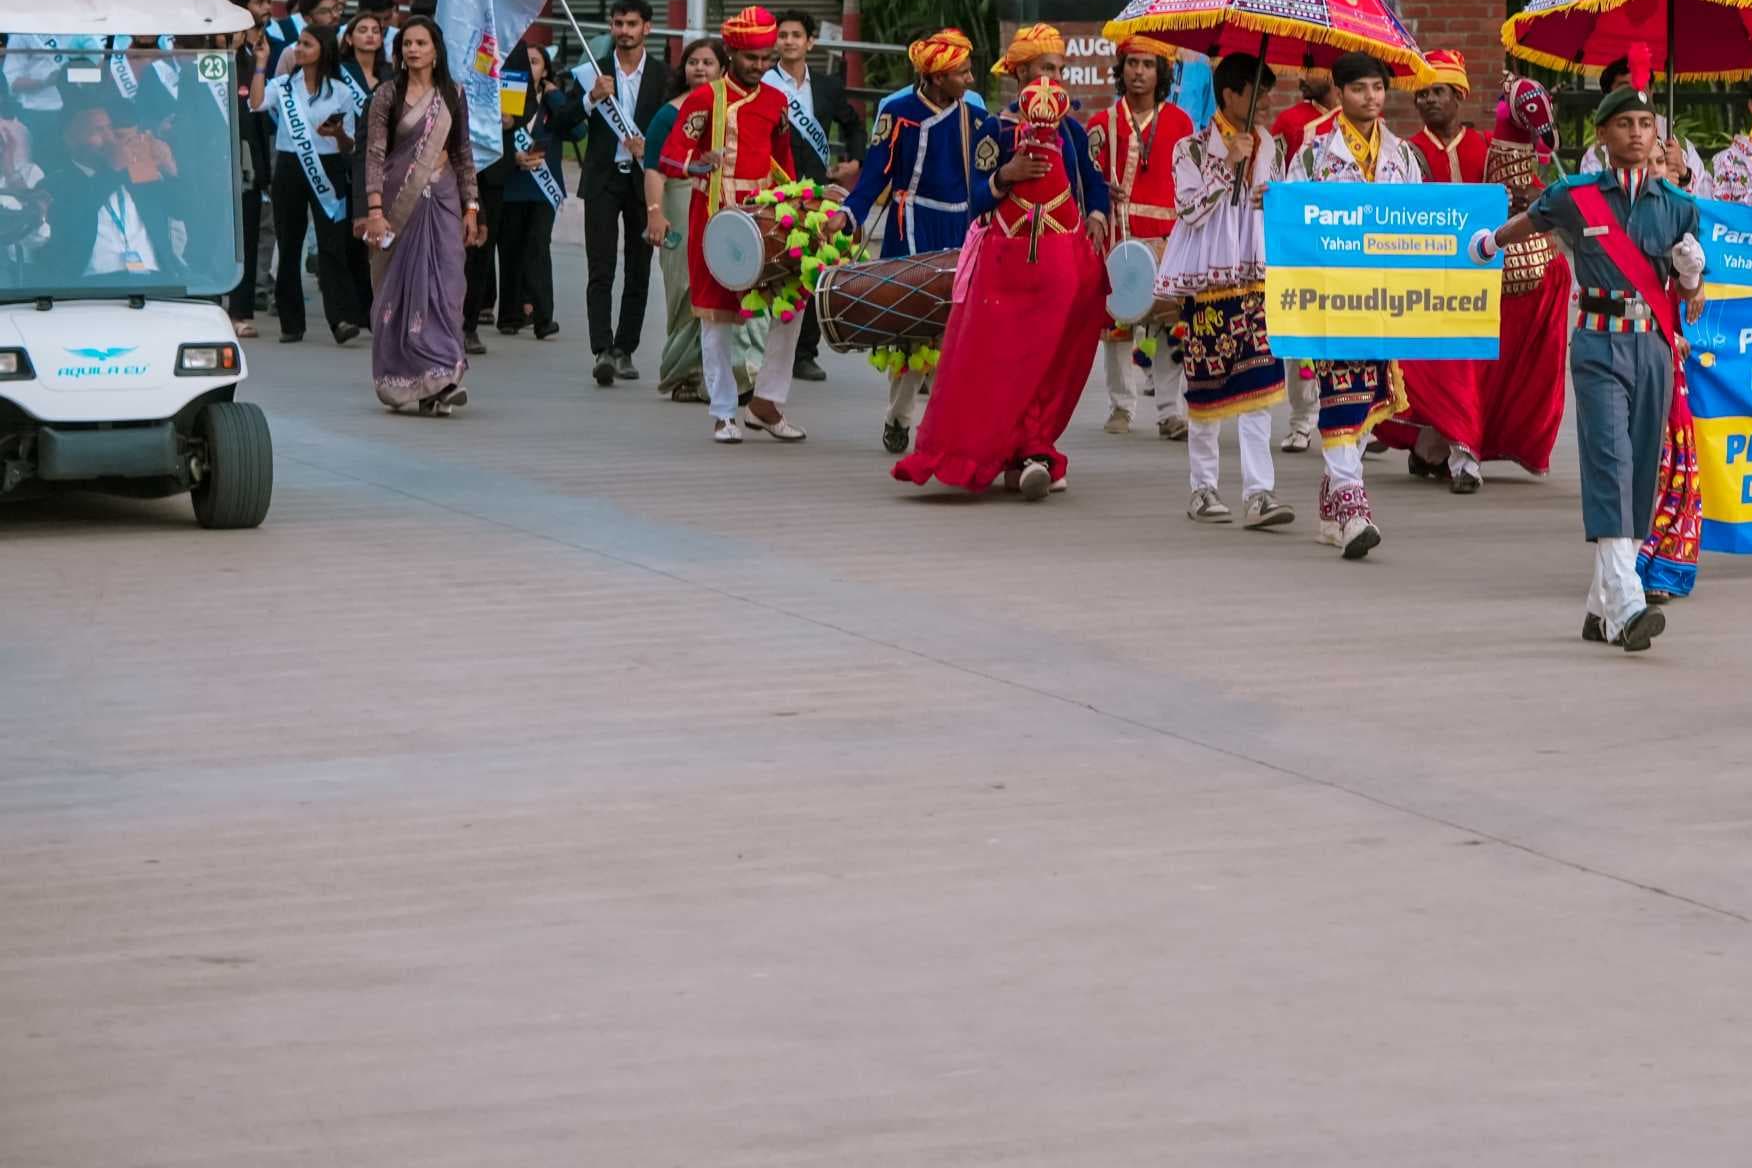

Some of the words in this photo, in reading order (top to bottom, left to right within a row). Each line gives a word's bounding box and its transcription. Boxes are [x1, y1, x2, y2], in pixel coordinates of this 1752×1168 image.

[204, 58, 224, 78] 23
[280, 83, 330, 195] ProudlyPlaced
[1375, 206, 1469, 231] University
[1321, 237, 1361, 251] Yahan
[1367, 236, 1422, 251] Possible
[1424, 238, 1453, 252] Hai!
[1280, 288, 1488, 318] #ProudlyPlaced
